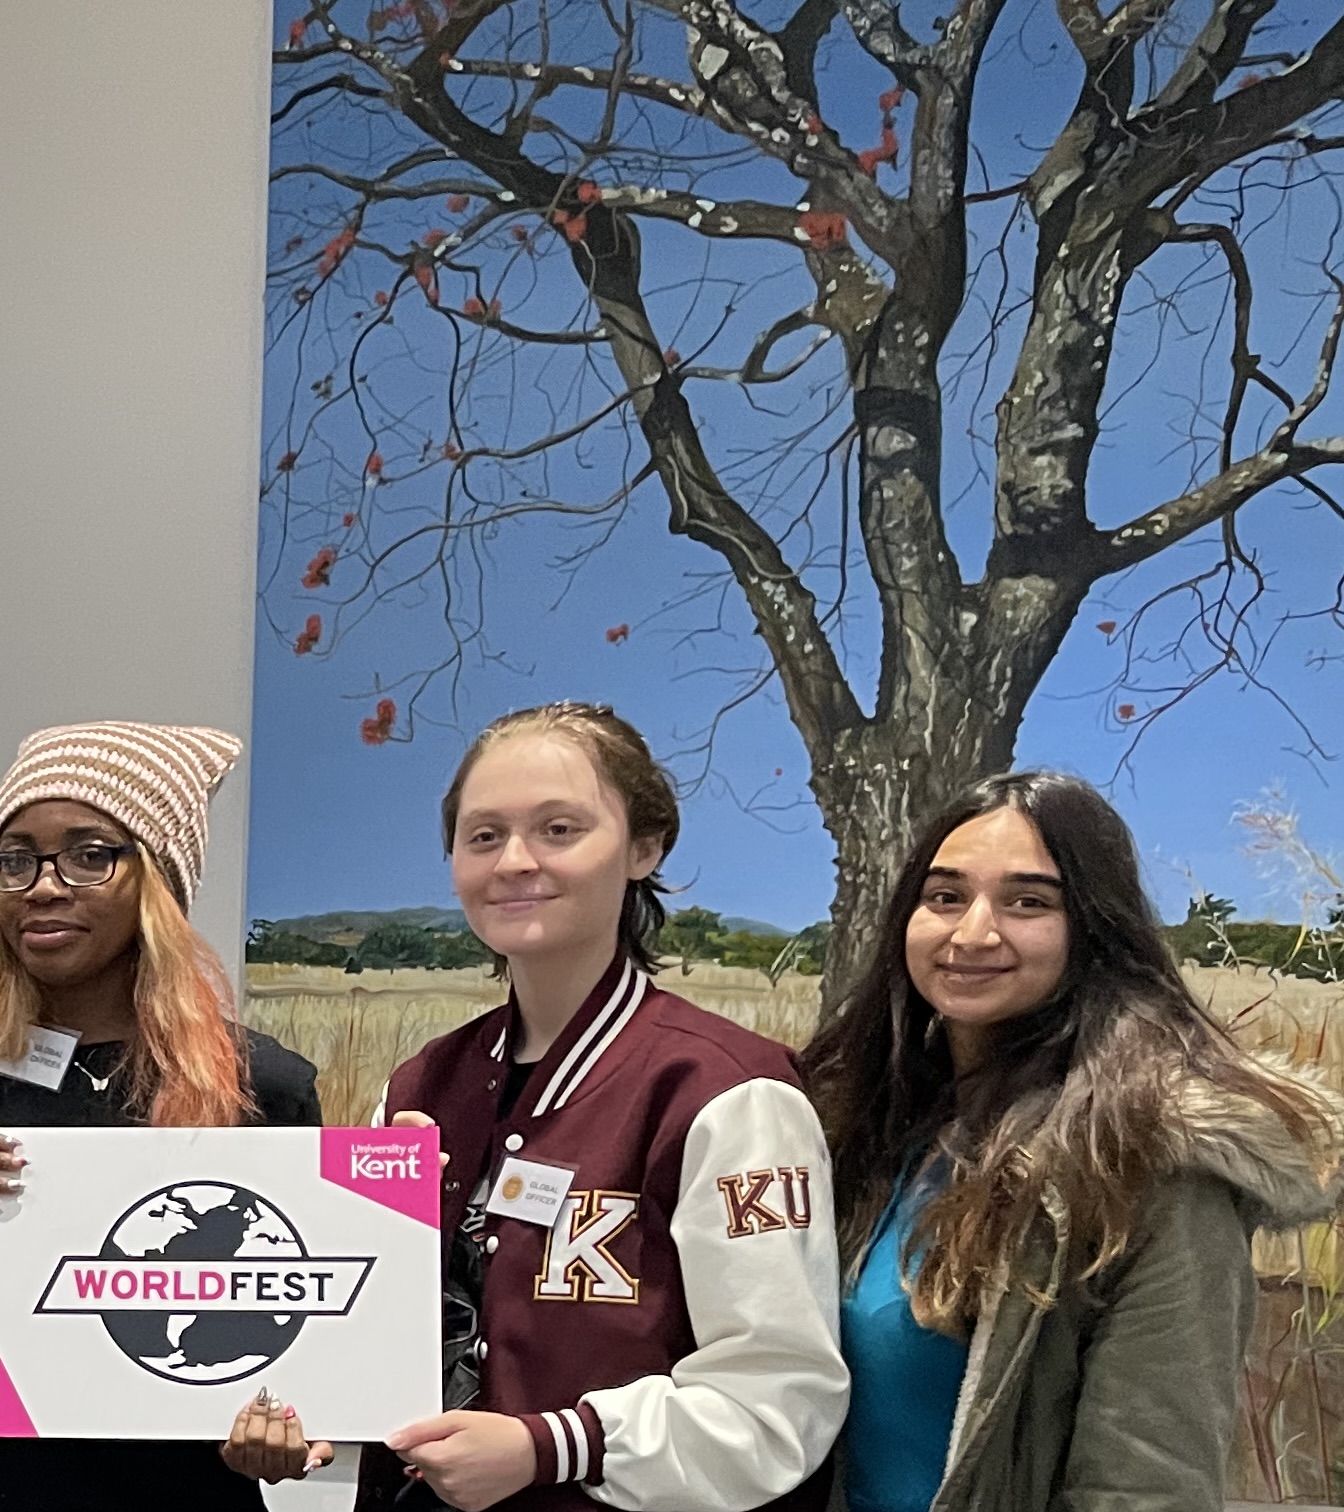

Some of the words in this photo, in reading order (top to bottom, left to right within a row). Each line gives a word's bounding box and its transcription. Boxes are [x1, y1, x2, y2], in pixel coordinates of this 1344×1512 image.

[351, 1144, 407, 1157] University
[408, 1143, 422, 1153] of
[351, 1154, 422, 1179] Kent
[525, 1192, 557, 1206] OFFICER
[529, 1181, 558, 1194] GLOBAL
[718, 1166, 812, 1239] KU
[533, 1189, 641, 1304] K
[73, 1269, 334, 1302] WORLDFEST
